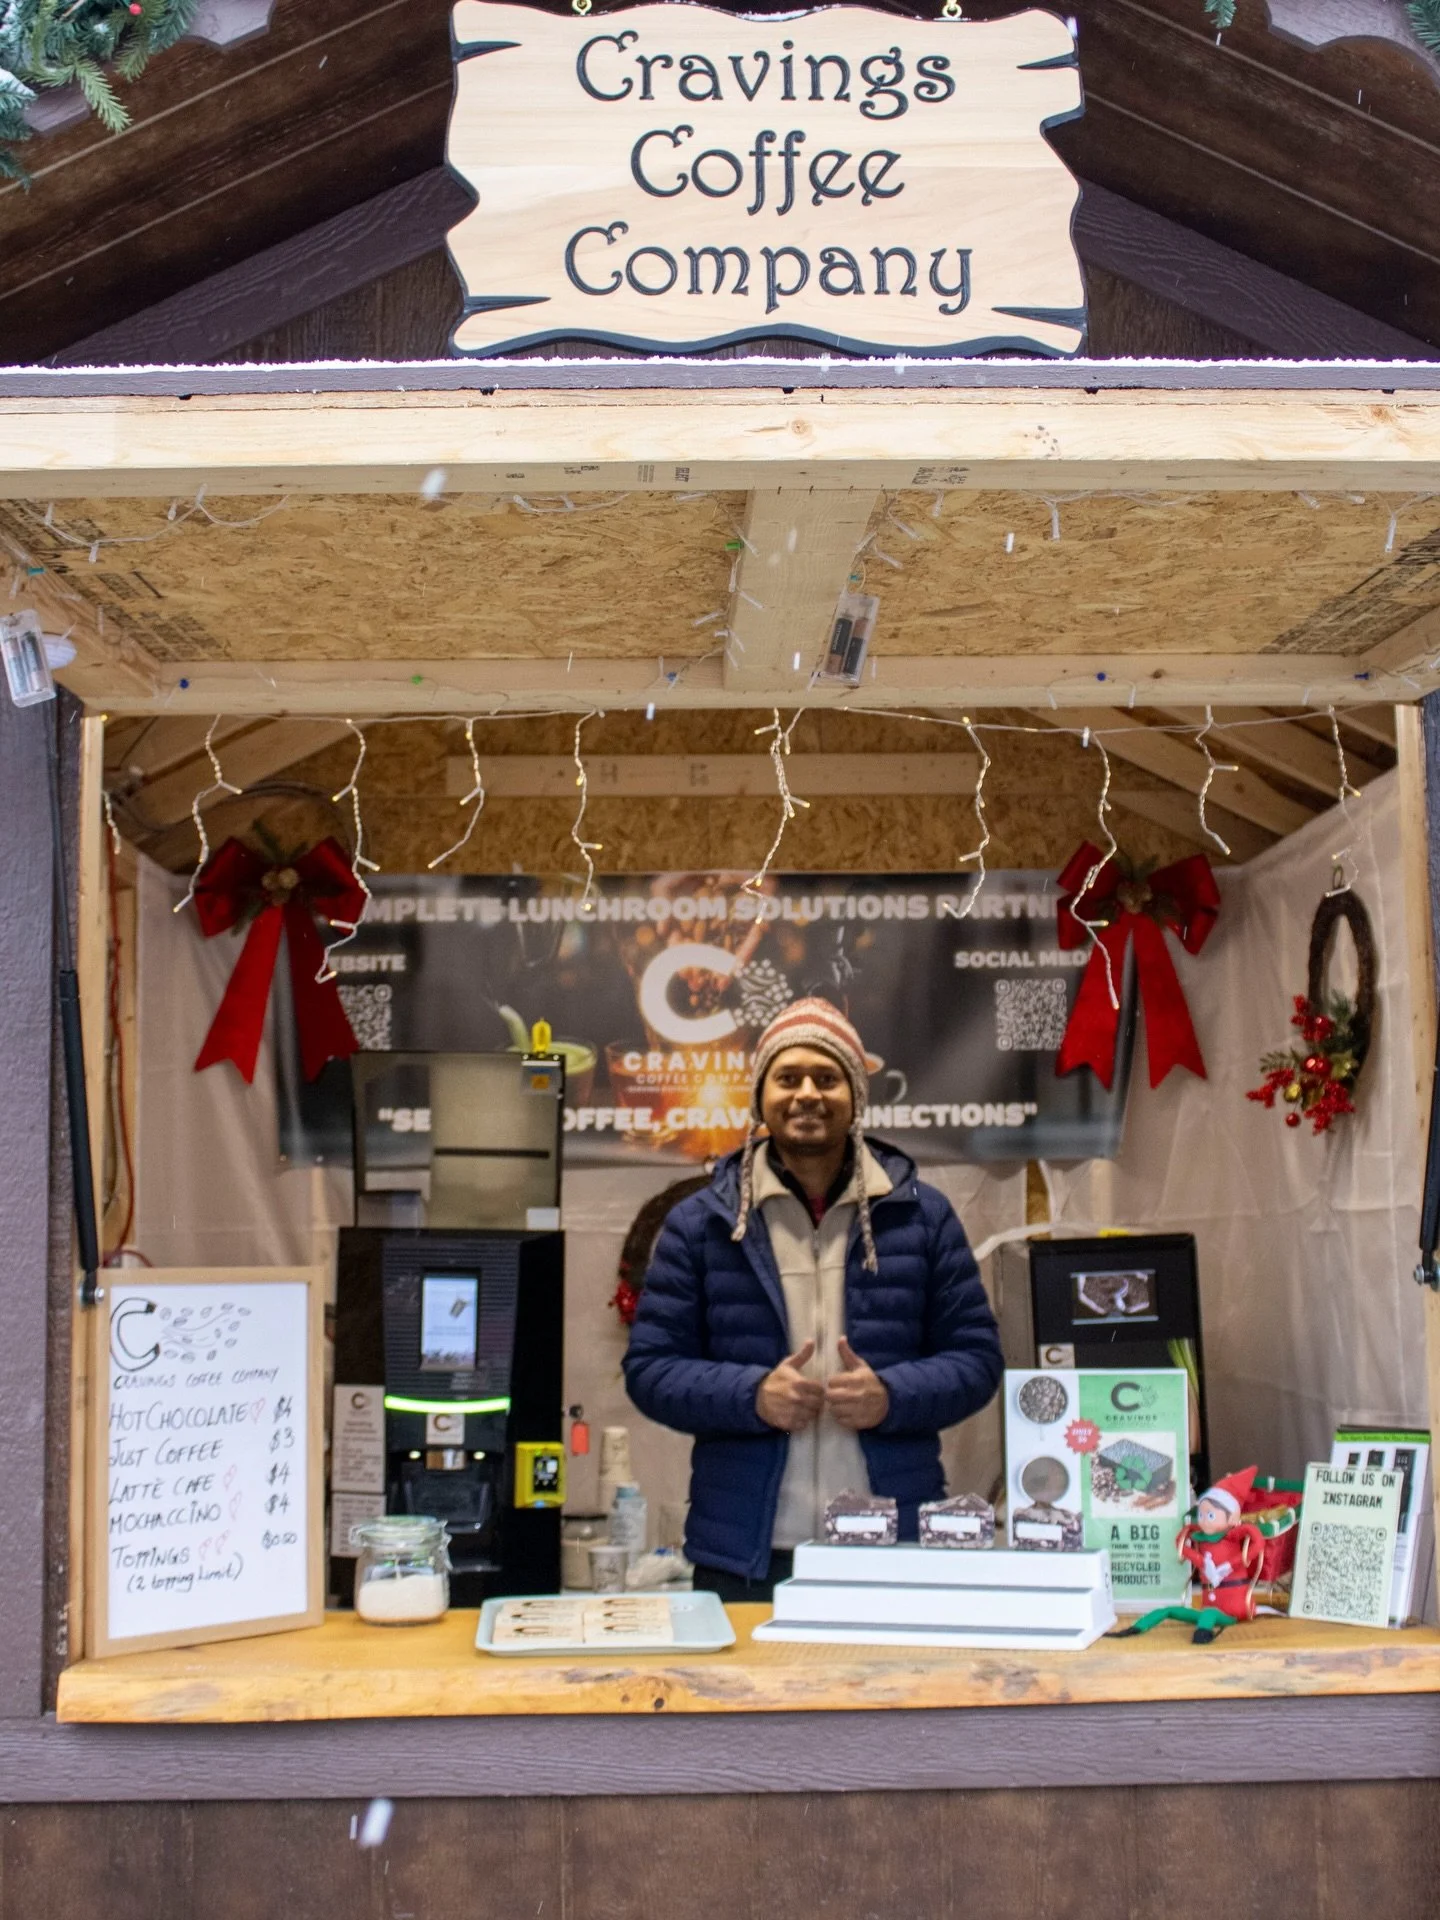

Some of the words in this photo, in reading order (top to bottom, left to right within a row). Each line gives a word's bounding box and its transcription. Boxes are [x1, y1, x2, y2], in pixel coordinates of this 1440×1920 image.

[576, 30, 956, 120] Cravings
[630, 124, 905, 216] Coffee
[564, 221, 973, 315] Company
[509, 896, 727, 922] LUNCHROOM
[735, 895, 929, 921] SOLUTIONS
[936, 893, 1057, 920] PARTN
[955, 951, 1035, 968] SOCIAL
[1039, 949, 1090, 967] MED
[623, 1051, 757, 1072] CRAVIN
[636, 1073, 688, 1085] COFFEE
[563, 1107, 661, 1133] OFFEE,
[666, 1106, 749, 1130] CRAV
[862, 1103, 1037, 1129] NECTIONS"
[154, 1437, 224, 1466] COFFEE
[268, 1426, 296, 1454] $3
[267, 1461, 290, 1487] $4
[1316, 1469, 1355, 1486] FOLLOW
[1361, 1471, 1376, 1487] US
[1382, 1473, 1396, 1488] ON
[264, 1493, 290, 1516] $4
[1323, 1491, 1384, 1509] INSTAGRAM
[1111, 1525, 1121, 1541] A
[1130, 1524, 1160, 1541] BIG
[112, 1544, 190, 1569] TOPPINGS
[1111, 1561, 1161, 1573] RECYCLED
[151, 1572, 194, 1593] topping
[1111, 1574, 1161, 1586] PRODUCTS
